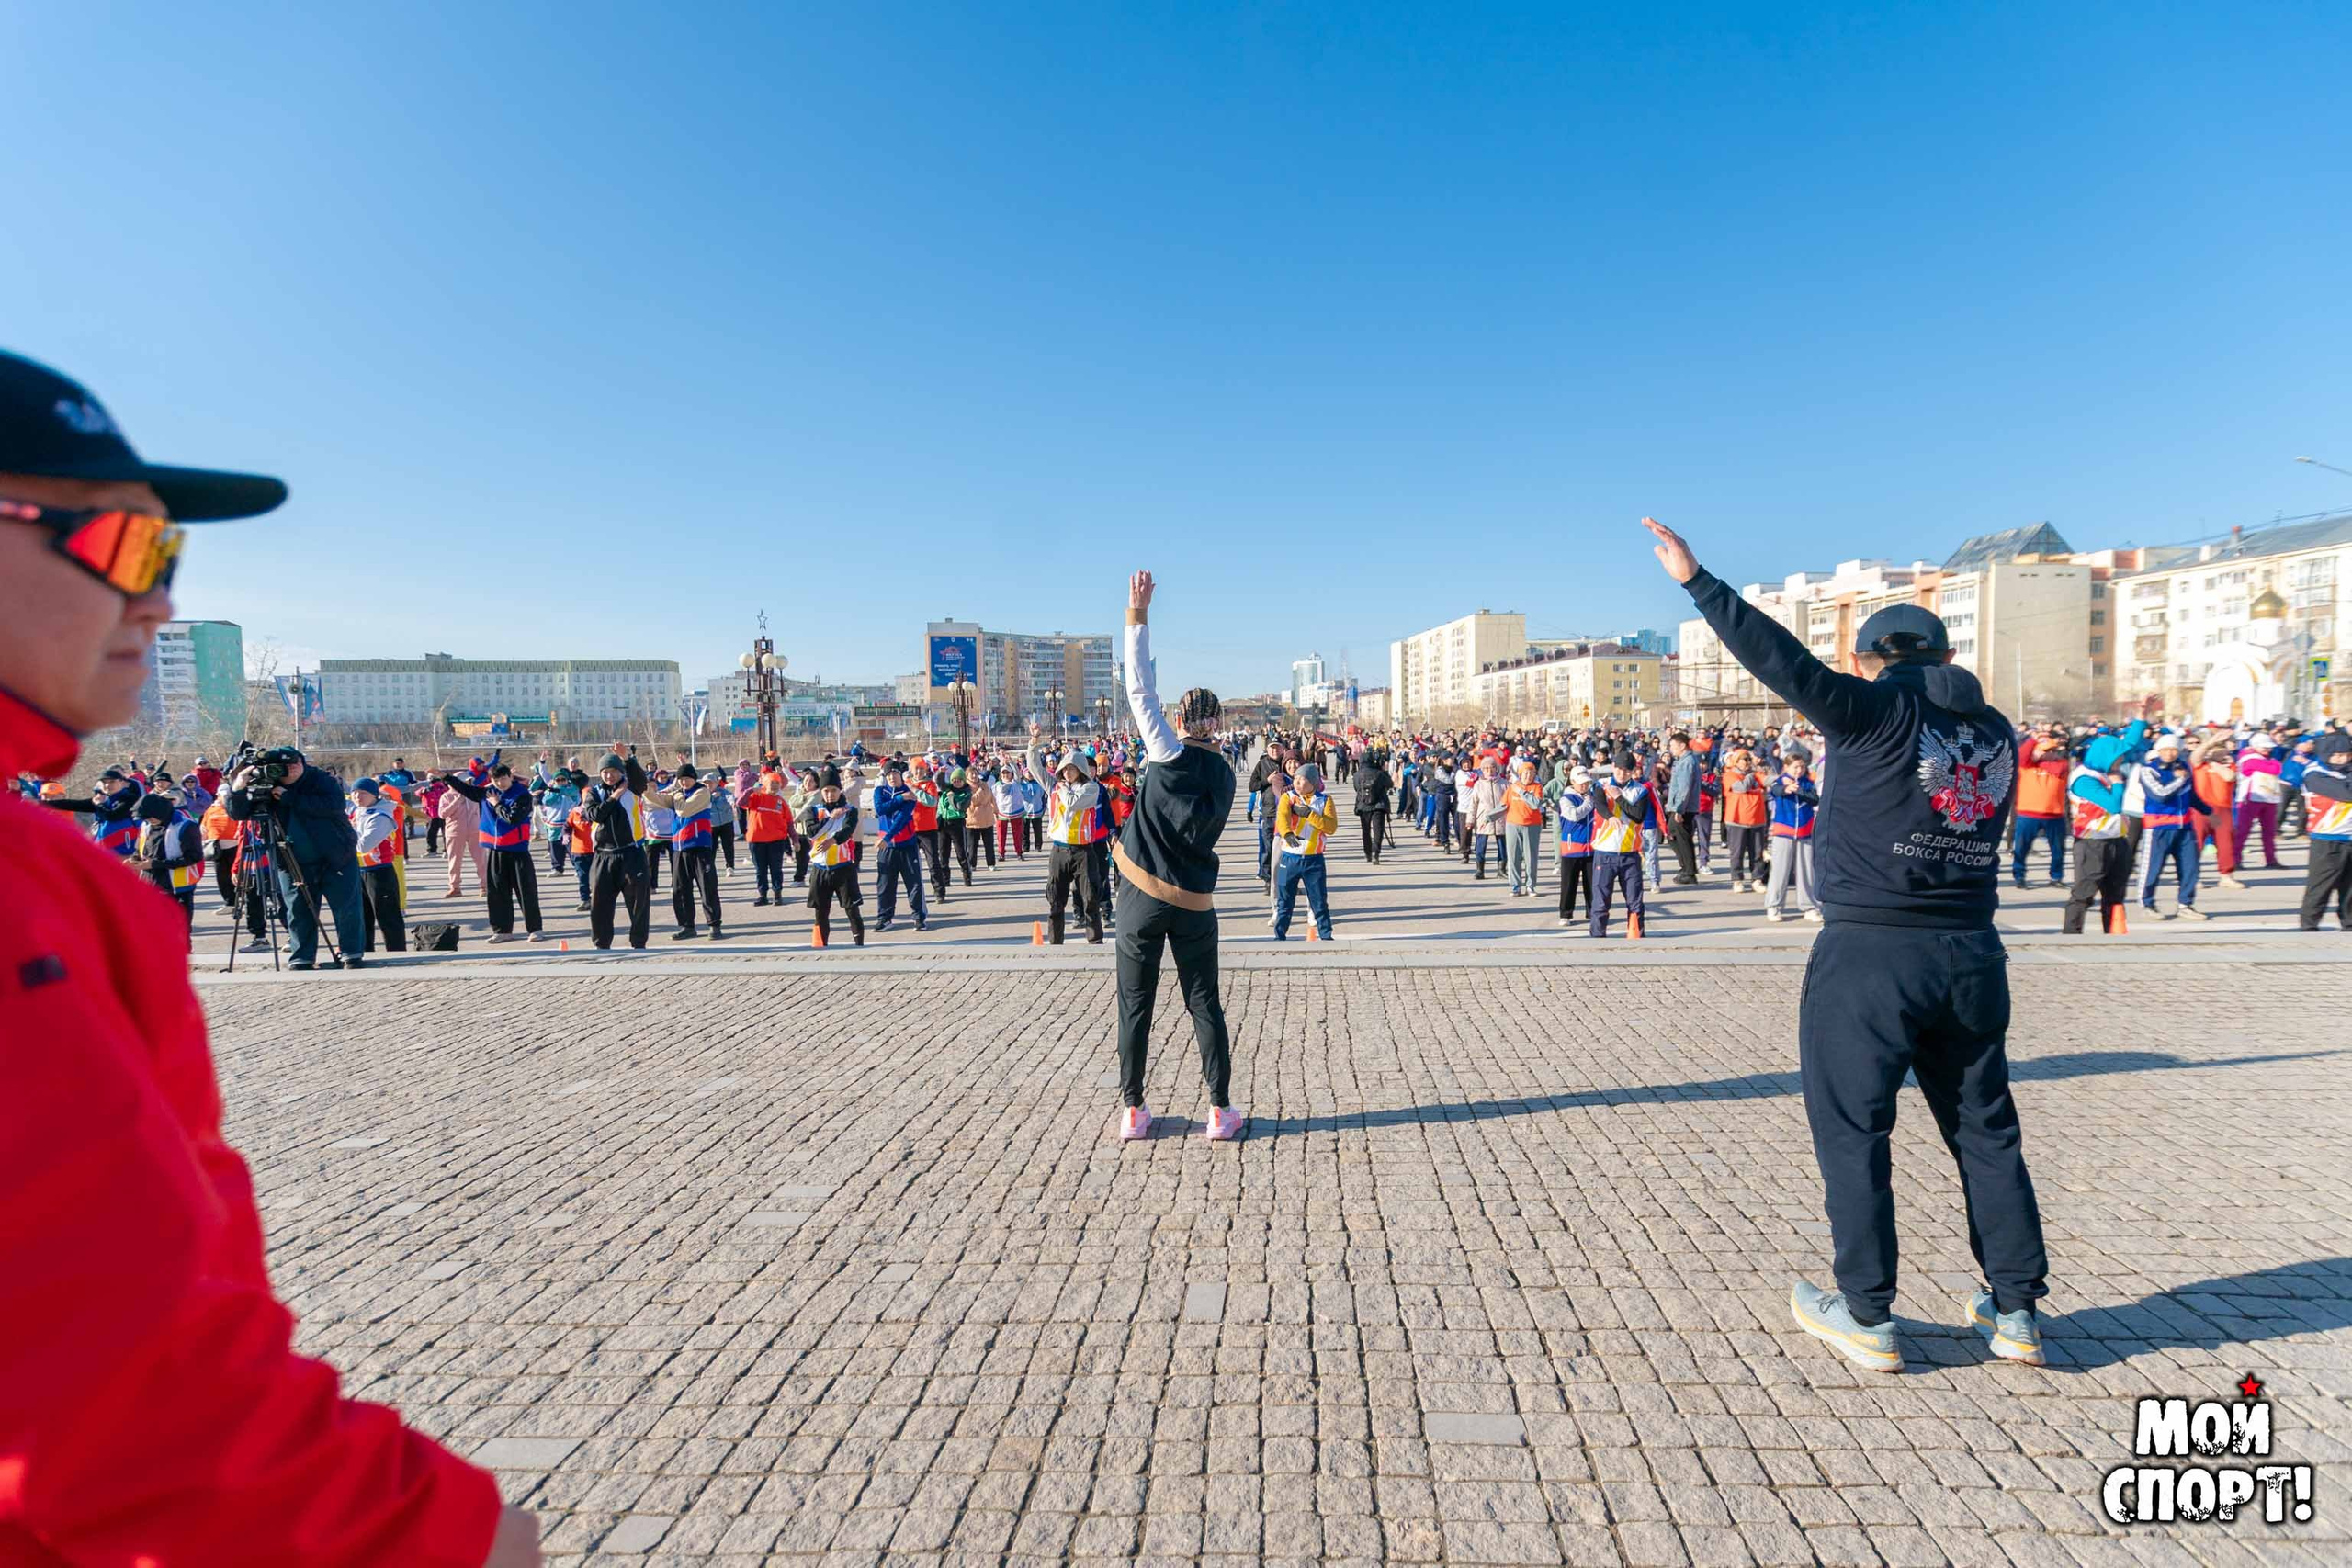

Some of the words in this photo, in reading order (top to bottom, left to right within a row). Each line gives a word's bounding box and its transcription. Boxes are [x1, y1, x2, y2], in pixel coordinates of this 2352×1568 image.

[1911, 832, 1991, 853] ФЕДЕРАЦИЯ
[1893, 842, 1940, 862] БОКСА
[1946, 851, 1993, 866] РОССИИ
